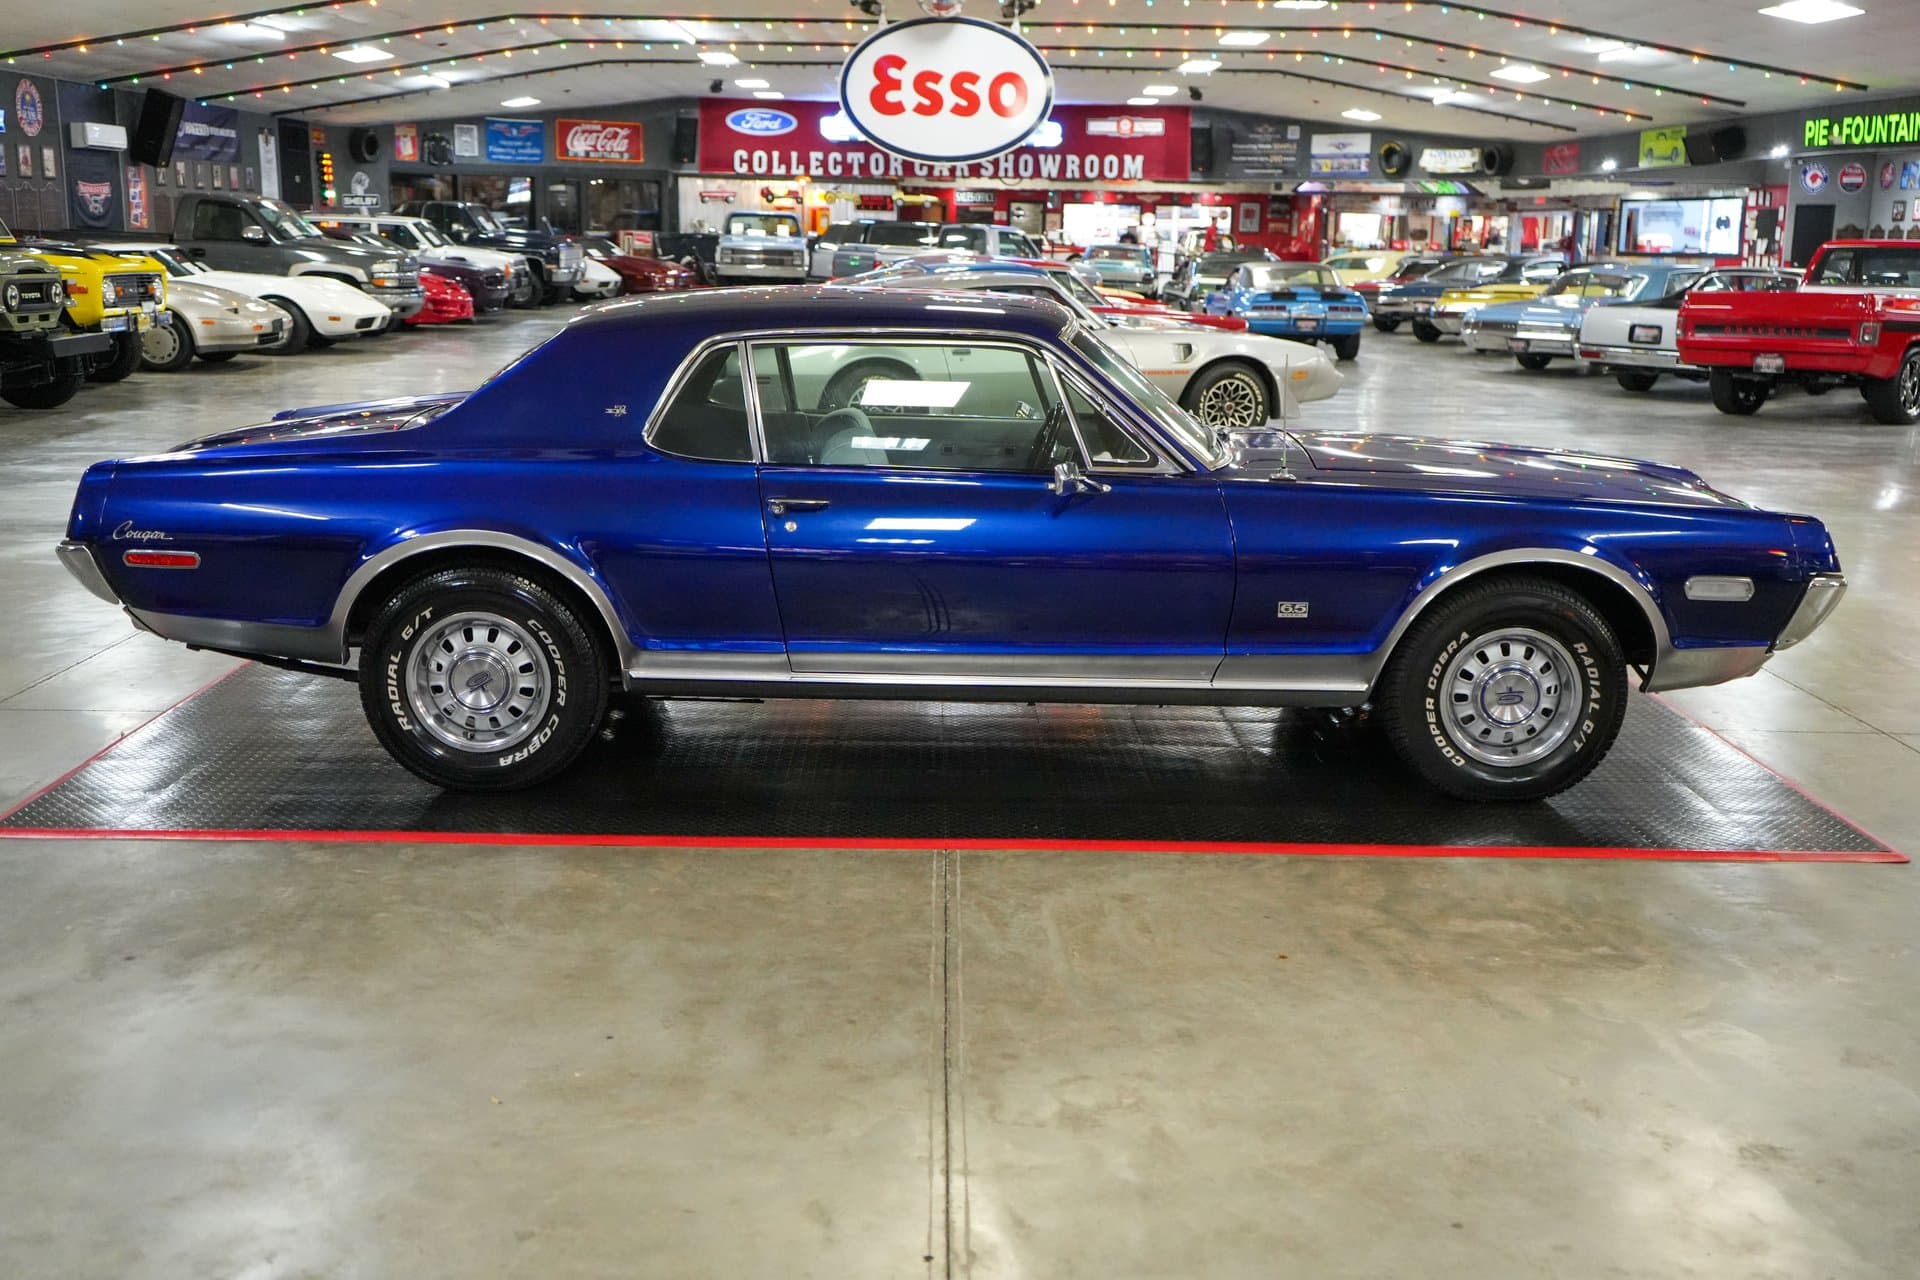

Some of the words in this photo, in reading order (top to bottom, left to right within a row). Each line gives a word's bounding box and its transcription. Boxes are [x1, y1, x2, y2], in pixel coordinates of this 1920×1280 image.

[742, 112, 781, 130] Ford
[1805, 119, 1829, 147] PIE
[733, 149, 904, 177] COLLECTOR
[913, 158, 971, 177] CAR
[979, 154, 1145, 179] SHOWROOM
[112, 520, 173, 542] Cougar
[385, 650, 414, 732] RADIAL
[401, 606, 433, 641] G/T
[527, 618, 567, 707] COOPER
[1427, 631, 1470, 690] COBRA
[1573, 642, 1600, 712] RADIAL
[499, 713, 560, 767] COBRA
[1426, 697, 1466, 767] COOPER
[1573, 719, 1594, 752] G/T
